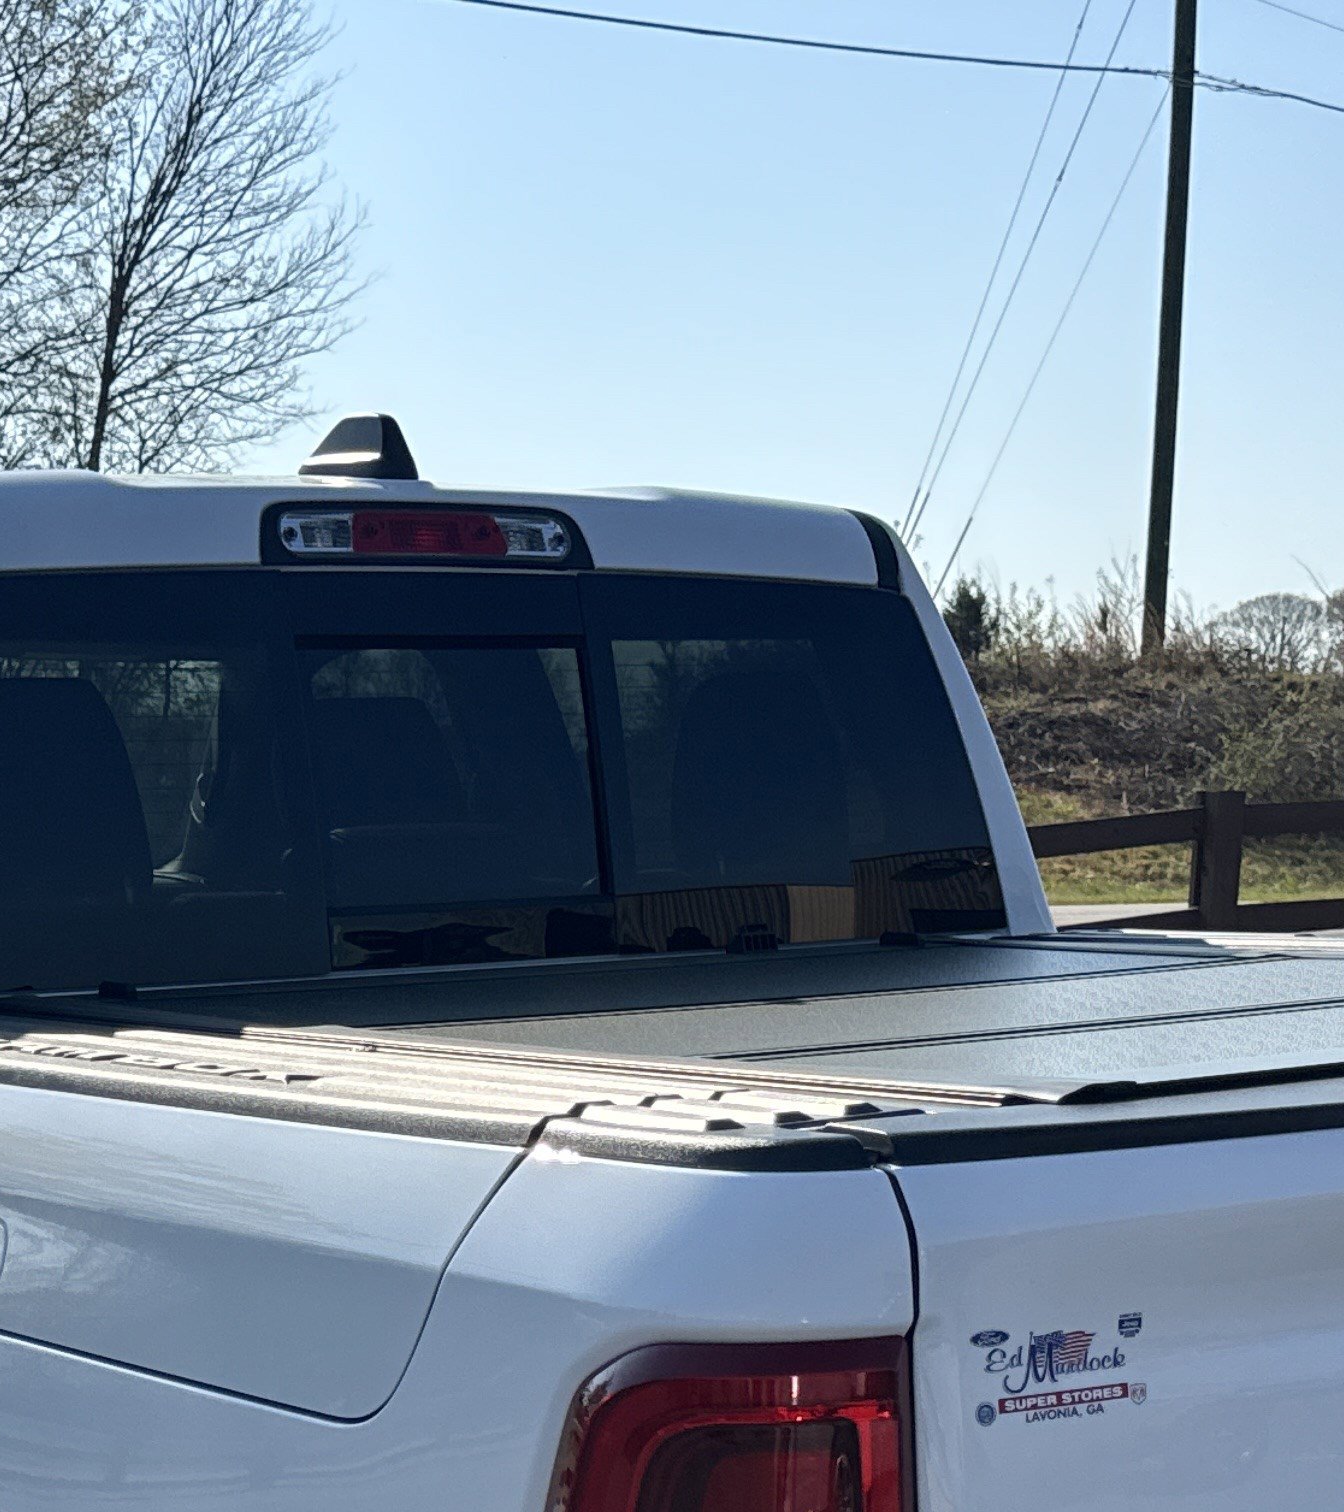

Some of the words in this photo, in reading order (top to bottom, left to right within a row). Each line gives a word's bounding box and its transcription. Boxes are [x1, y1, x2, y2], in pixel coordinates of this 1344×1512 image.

[984, 1346, 1023, 1374] Ed
[1002, 1340, 1127, 1394] Murdock
[1004, 1394, 1057, 1412] SUPER
[1061, 1386, 1123, 1406] STORES
[1025, 1405, 1082, 1424] LAVONIA,
[1086, 1403, 1105, 1415] GA
